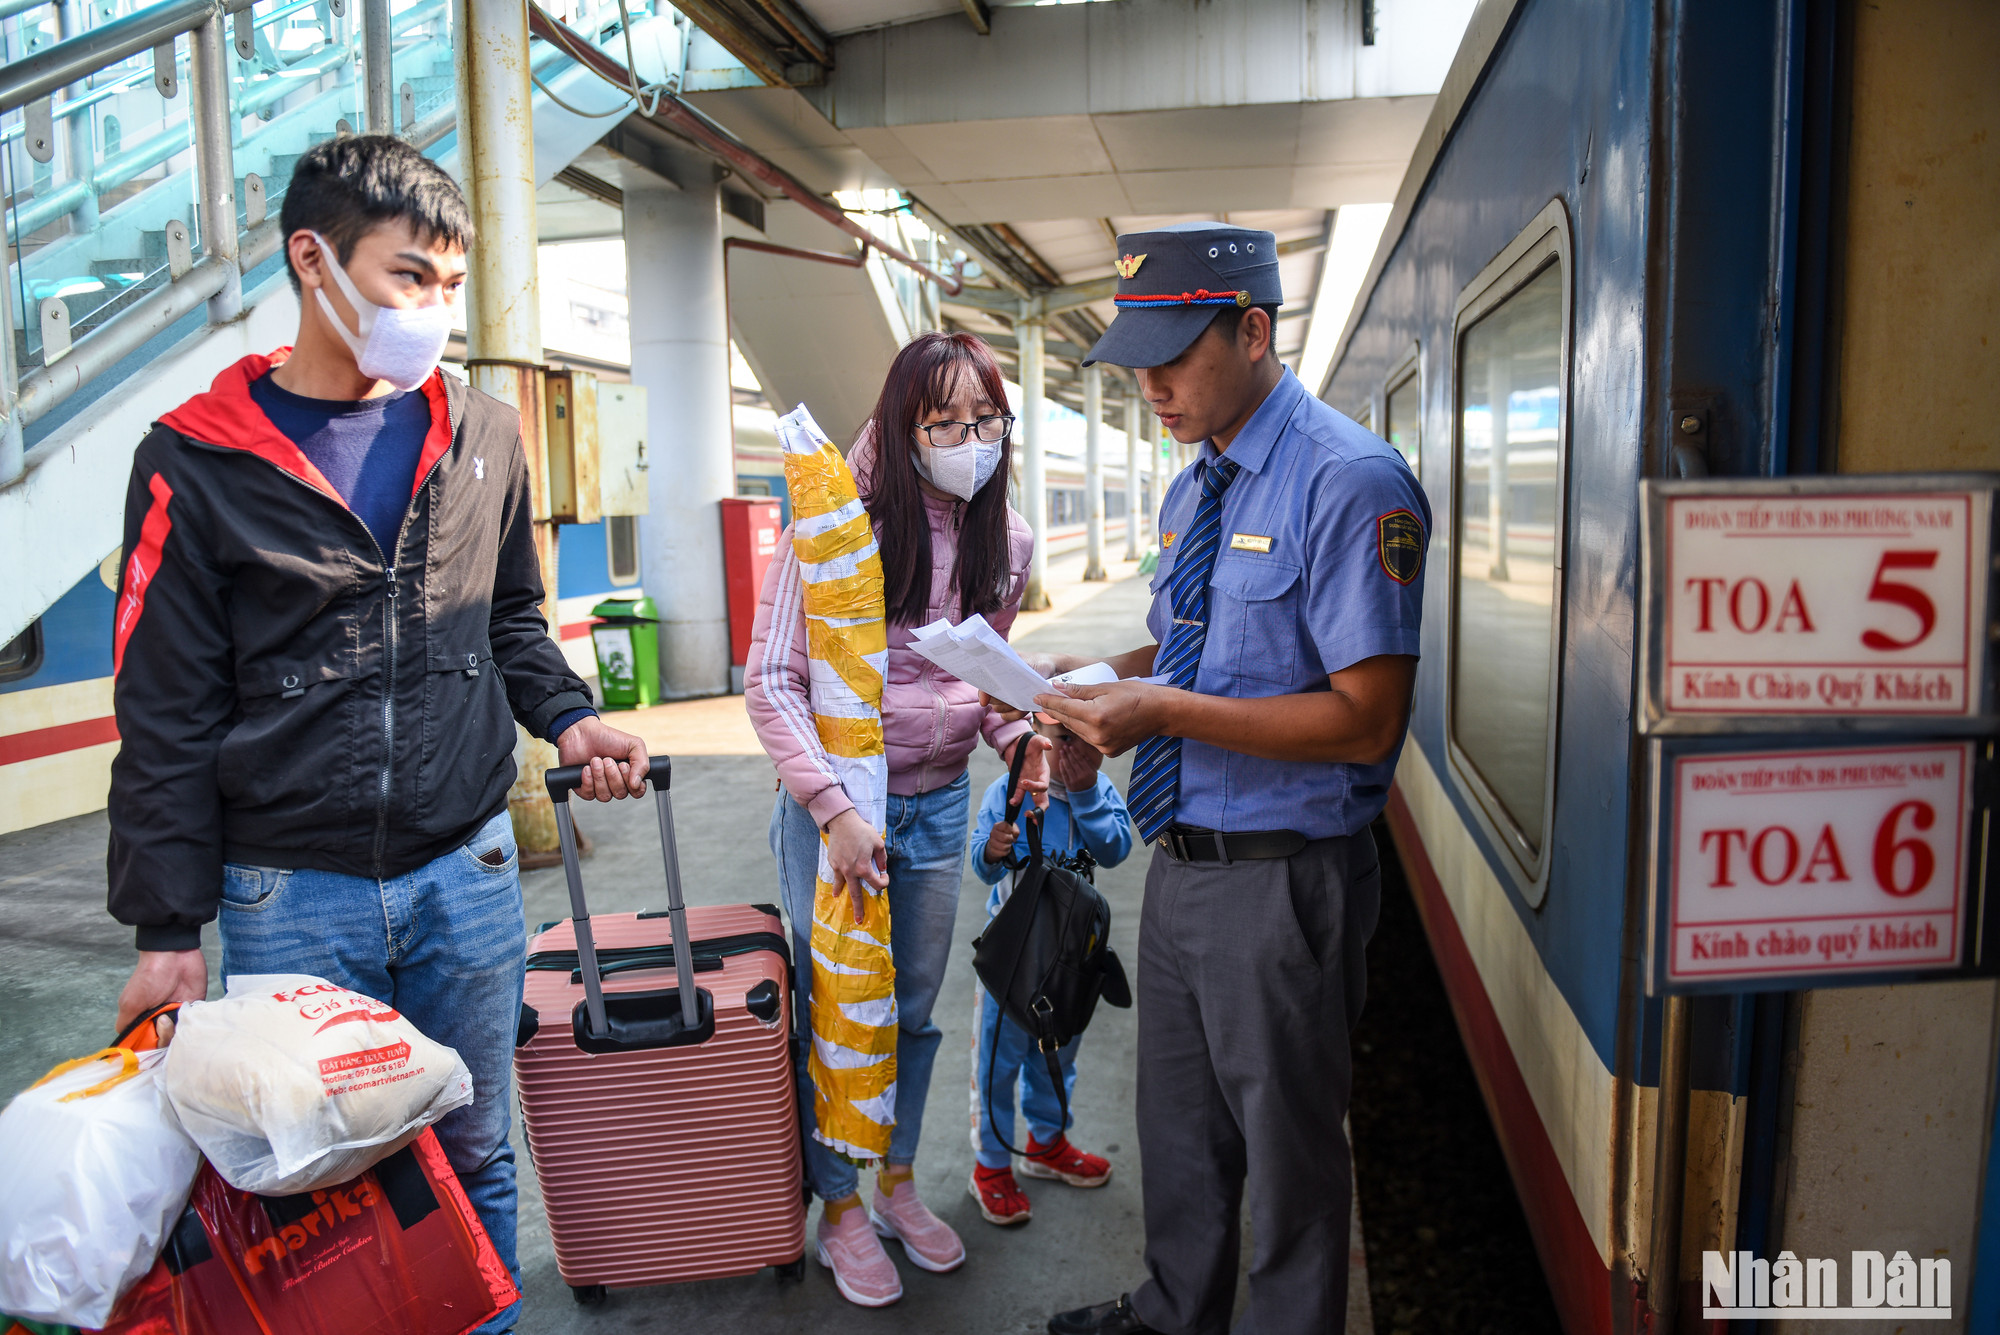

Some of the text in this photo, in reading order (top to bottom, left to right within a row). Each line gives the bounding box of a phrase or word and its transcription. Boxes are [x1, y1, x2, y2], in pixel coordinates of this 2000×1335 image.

[1914, 509, 1953, 528] NAM
[1684, 549, 1940, 652] TOA 5
[1683, 671, 1954, 708] Kính Chào Quý Khách
[1909, 762, 1945, 780] NAM
[1700, 799, 1936, 898] TOA 6
[1690, 921, 1938, 961] Kính chào quý khách
[299, 998, 341, 1020] Giá
[321, 1060, 340, 1073] ĐẶT
[341, 1055, 363, 1069] HÀNG
[364, 1051, 385, 1065] TRỰC
[322, 1061, 407, 1086] Hotline: 097 665 8183
[325, 1066, 425, 1097] Web: ecomartvietnam.vn
[314, 1253, 341, 1272] Butter
[342, 1234, 374, 1256] Cookies
